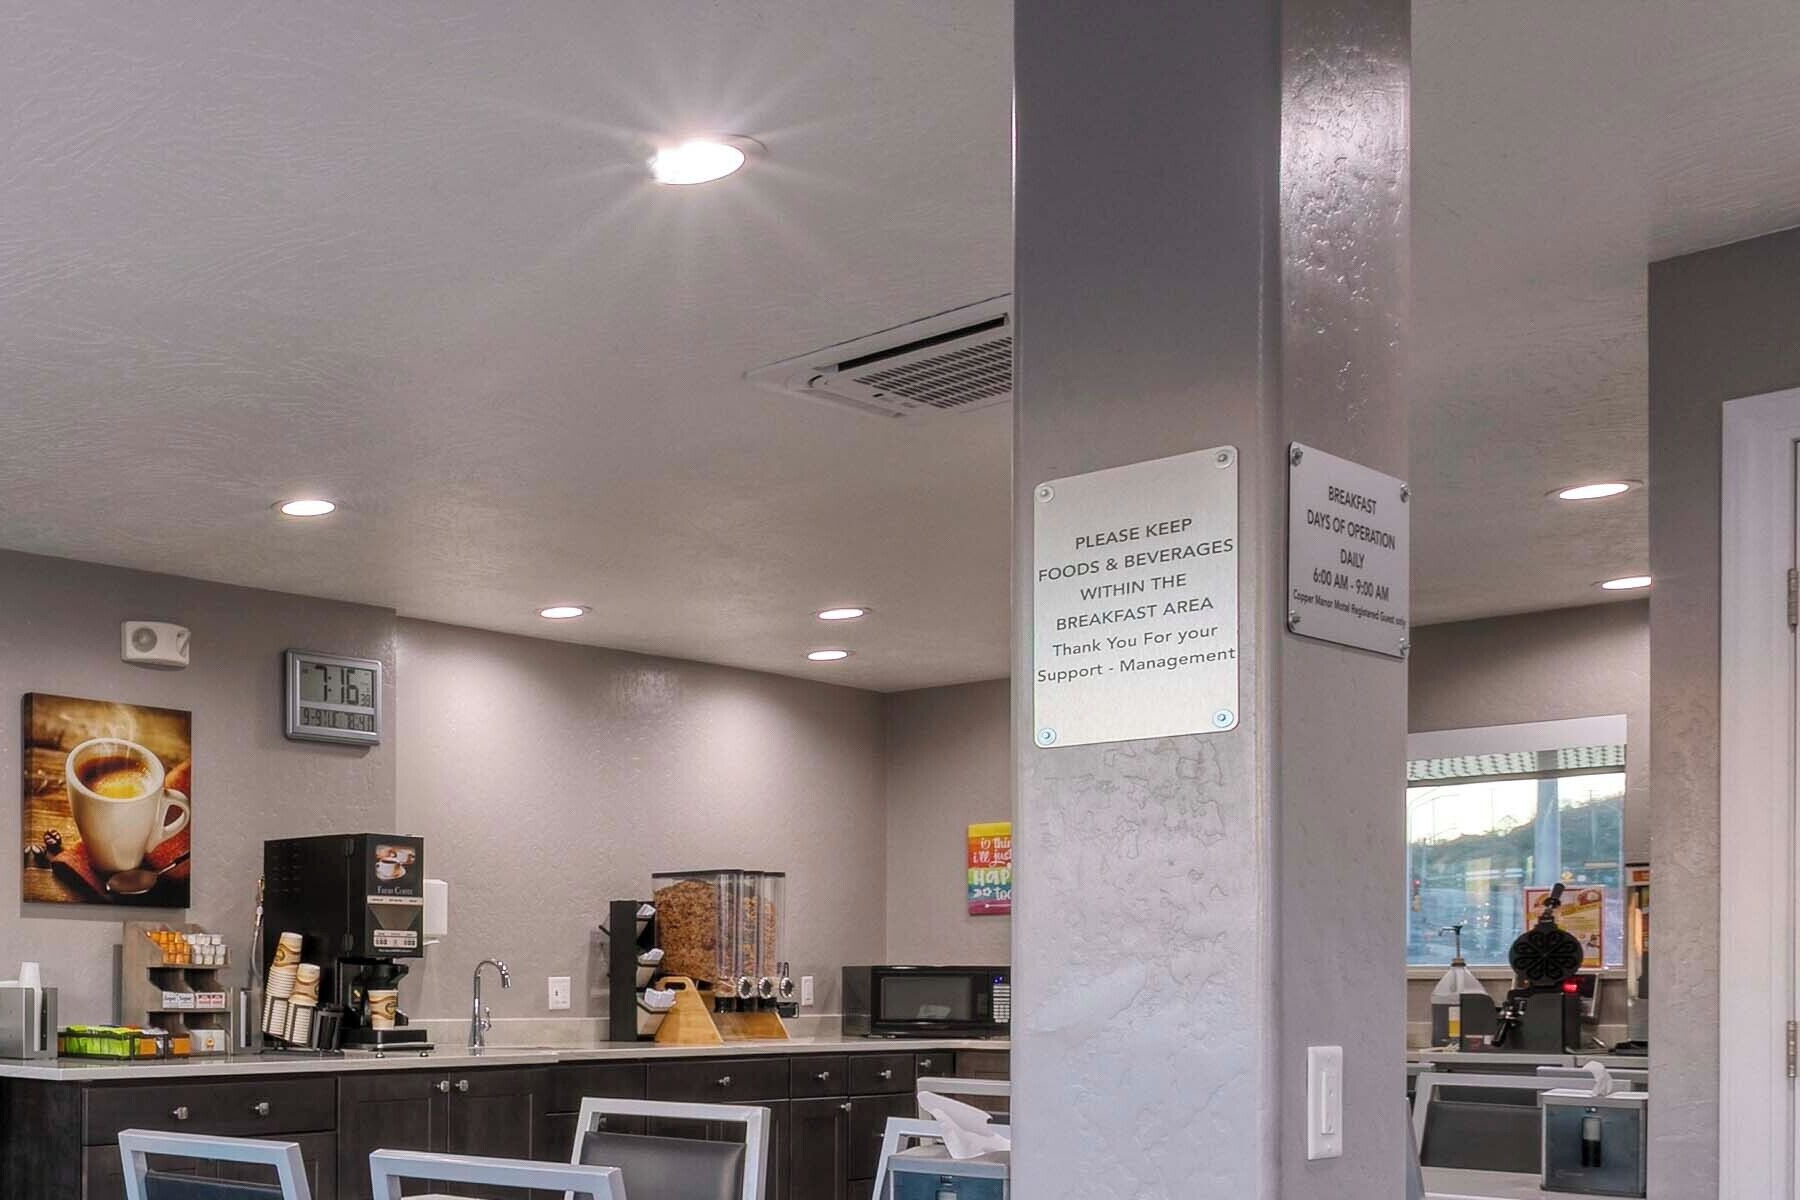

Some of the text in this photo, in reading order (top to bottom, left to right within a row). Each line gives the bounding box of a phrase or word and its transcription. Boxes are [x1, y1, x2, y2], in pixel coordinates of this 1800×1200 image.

[1328, 486, 1376, 515] BREAKFAST
[1075, 518, 1192, 550] PLEASE KEEP
[1307, 509, 1395, 550] DAYS OF OPERATION
[1038, 538, 1234, 582] FOODS & BEVERAGES
[1340, 548, 1365, 568] DAILY
[1080, 573, 1187, 601] WITHIN THE
[1313, 567, 1332, 586] 6:00
[1334, 573, 1348, 591] AM
[1356, 579, 1374, 597] 9:00
[1375, 585, 1389, 601] AM
[1056, 597, 1214, 631] BREAKFAST AREA
[1053, 626, 1218, 657] Thank You For your
[1037, 664, 1103, 684] Support
[1120, 648, 1236, 673] Management
[315, 664, 359, 705] 7:16
